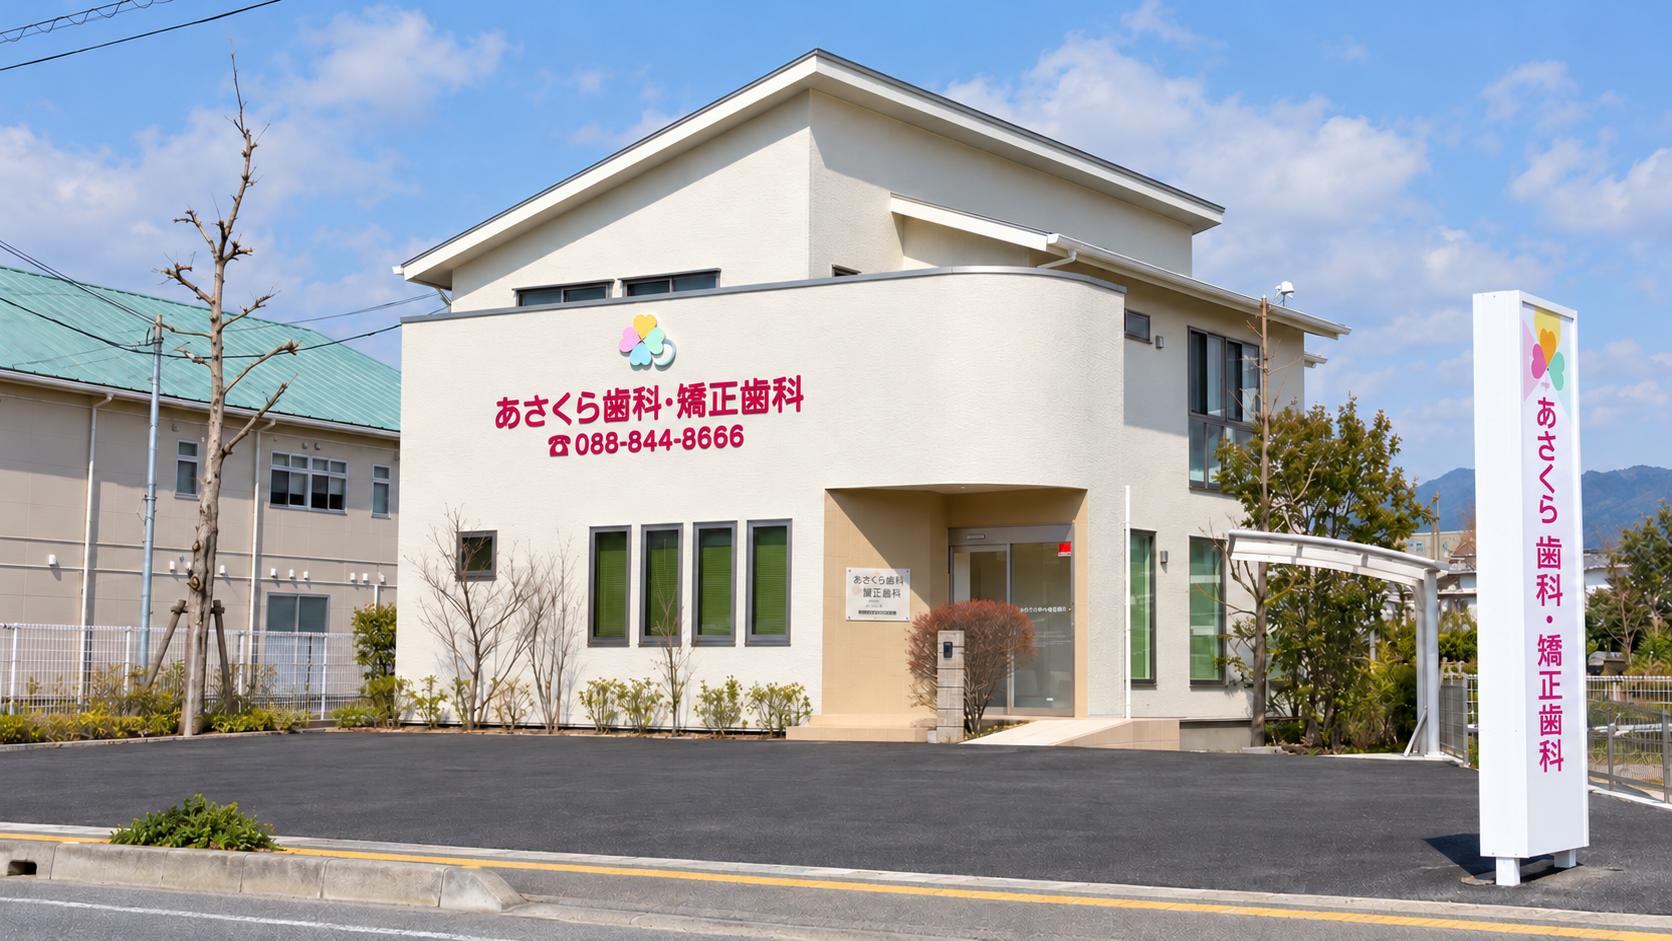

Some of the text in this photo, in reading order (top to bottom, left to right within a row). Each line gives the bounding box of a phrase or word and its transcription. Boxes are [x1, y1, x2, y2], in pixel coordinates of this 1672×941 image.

[495, 374, 805, 430] あさくら歯科・矯正歯科
[574, 424, 745, 456] 088-844-8666
